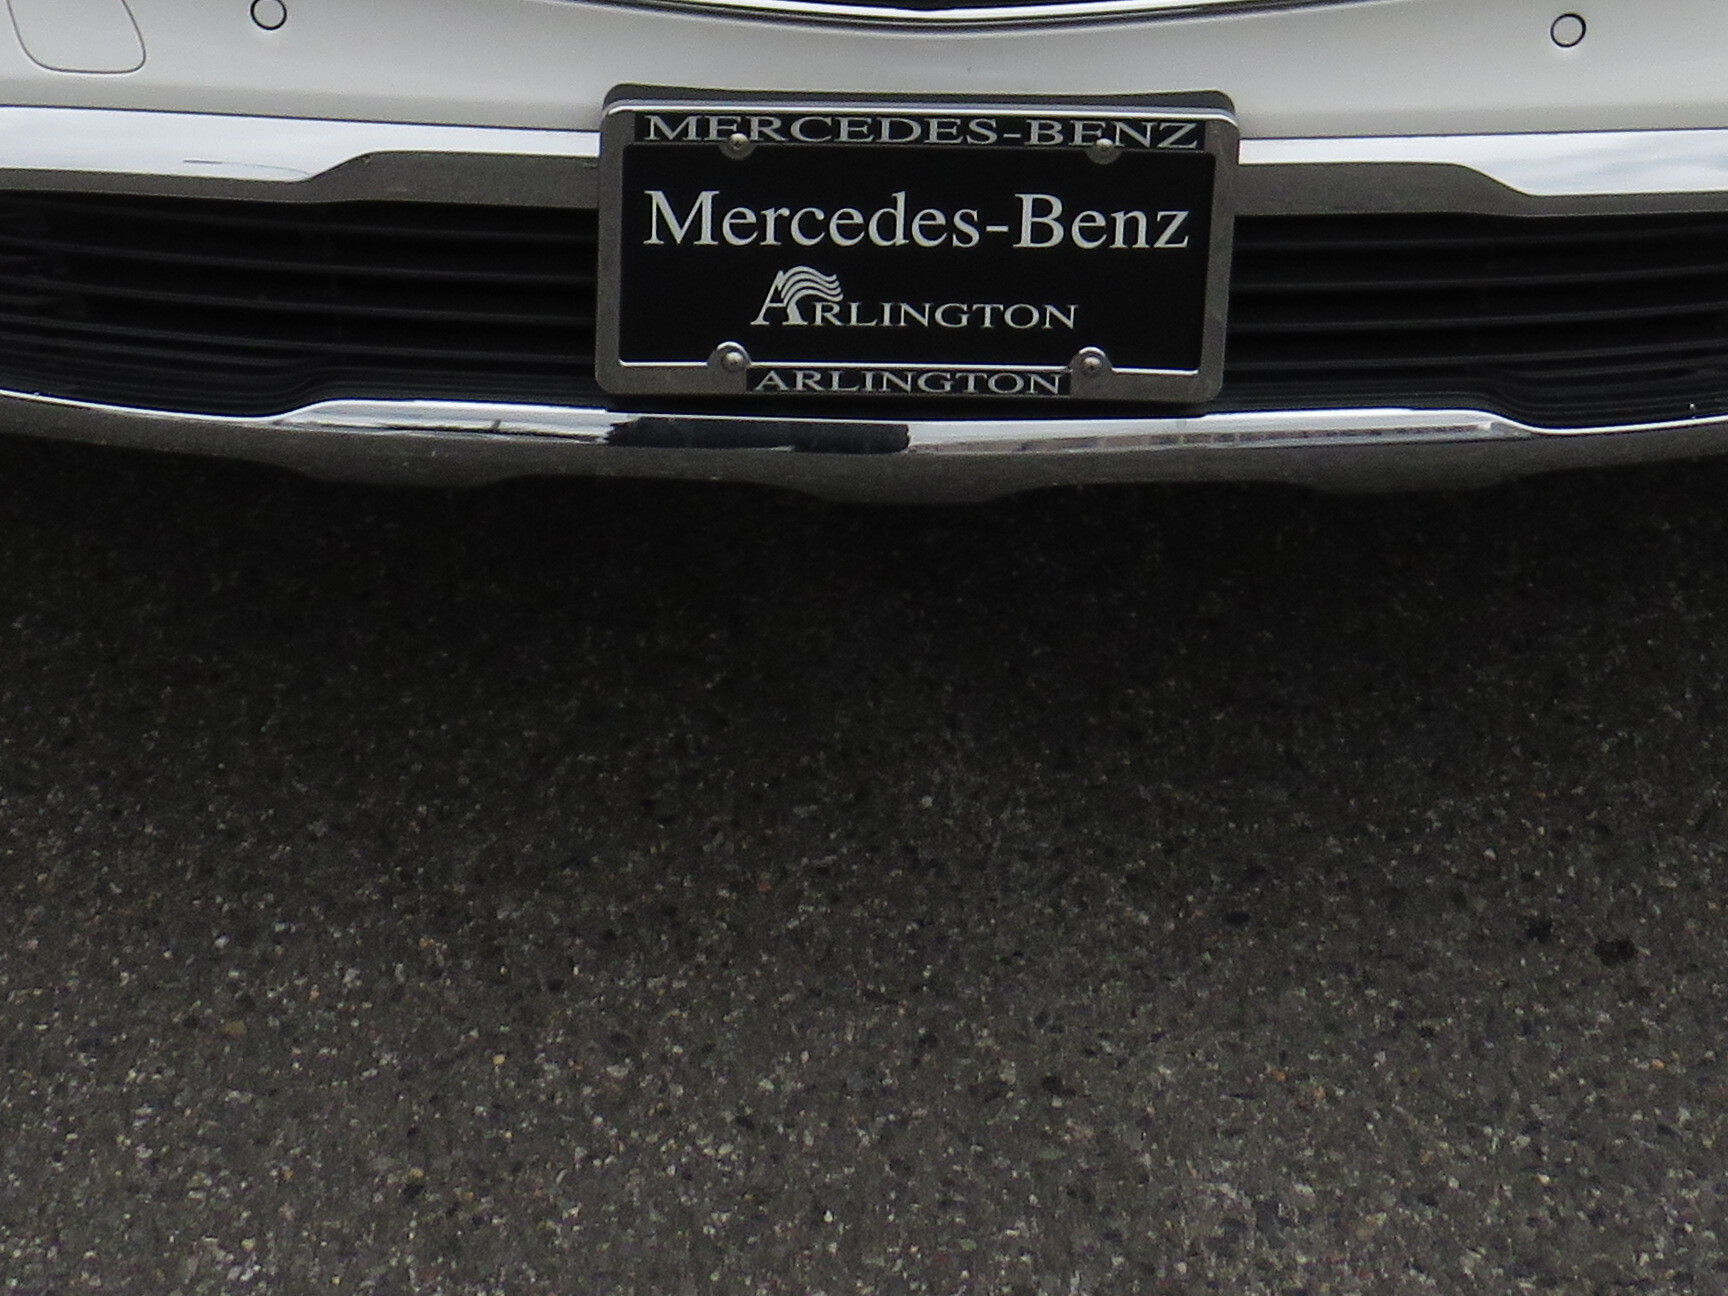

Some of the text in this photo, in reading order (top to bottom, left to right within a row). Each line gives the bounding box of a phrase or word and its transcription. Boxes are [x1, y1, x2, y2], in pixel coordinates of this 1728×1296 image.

[644, 113, 1198, 150] MERCEDES-BENZ
[643, 189, 1190, 249] Mercedes-Benz
[754, 368, 1063, 395] ARLINGTON
